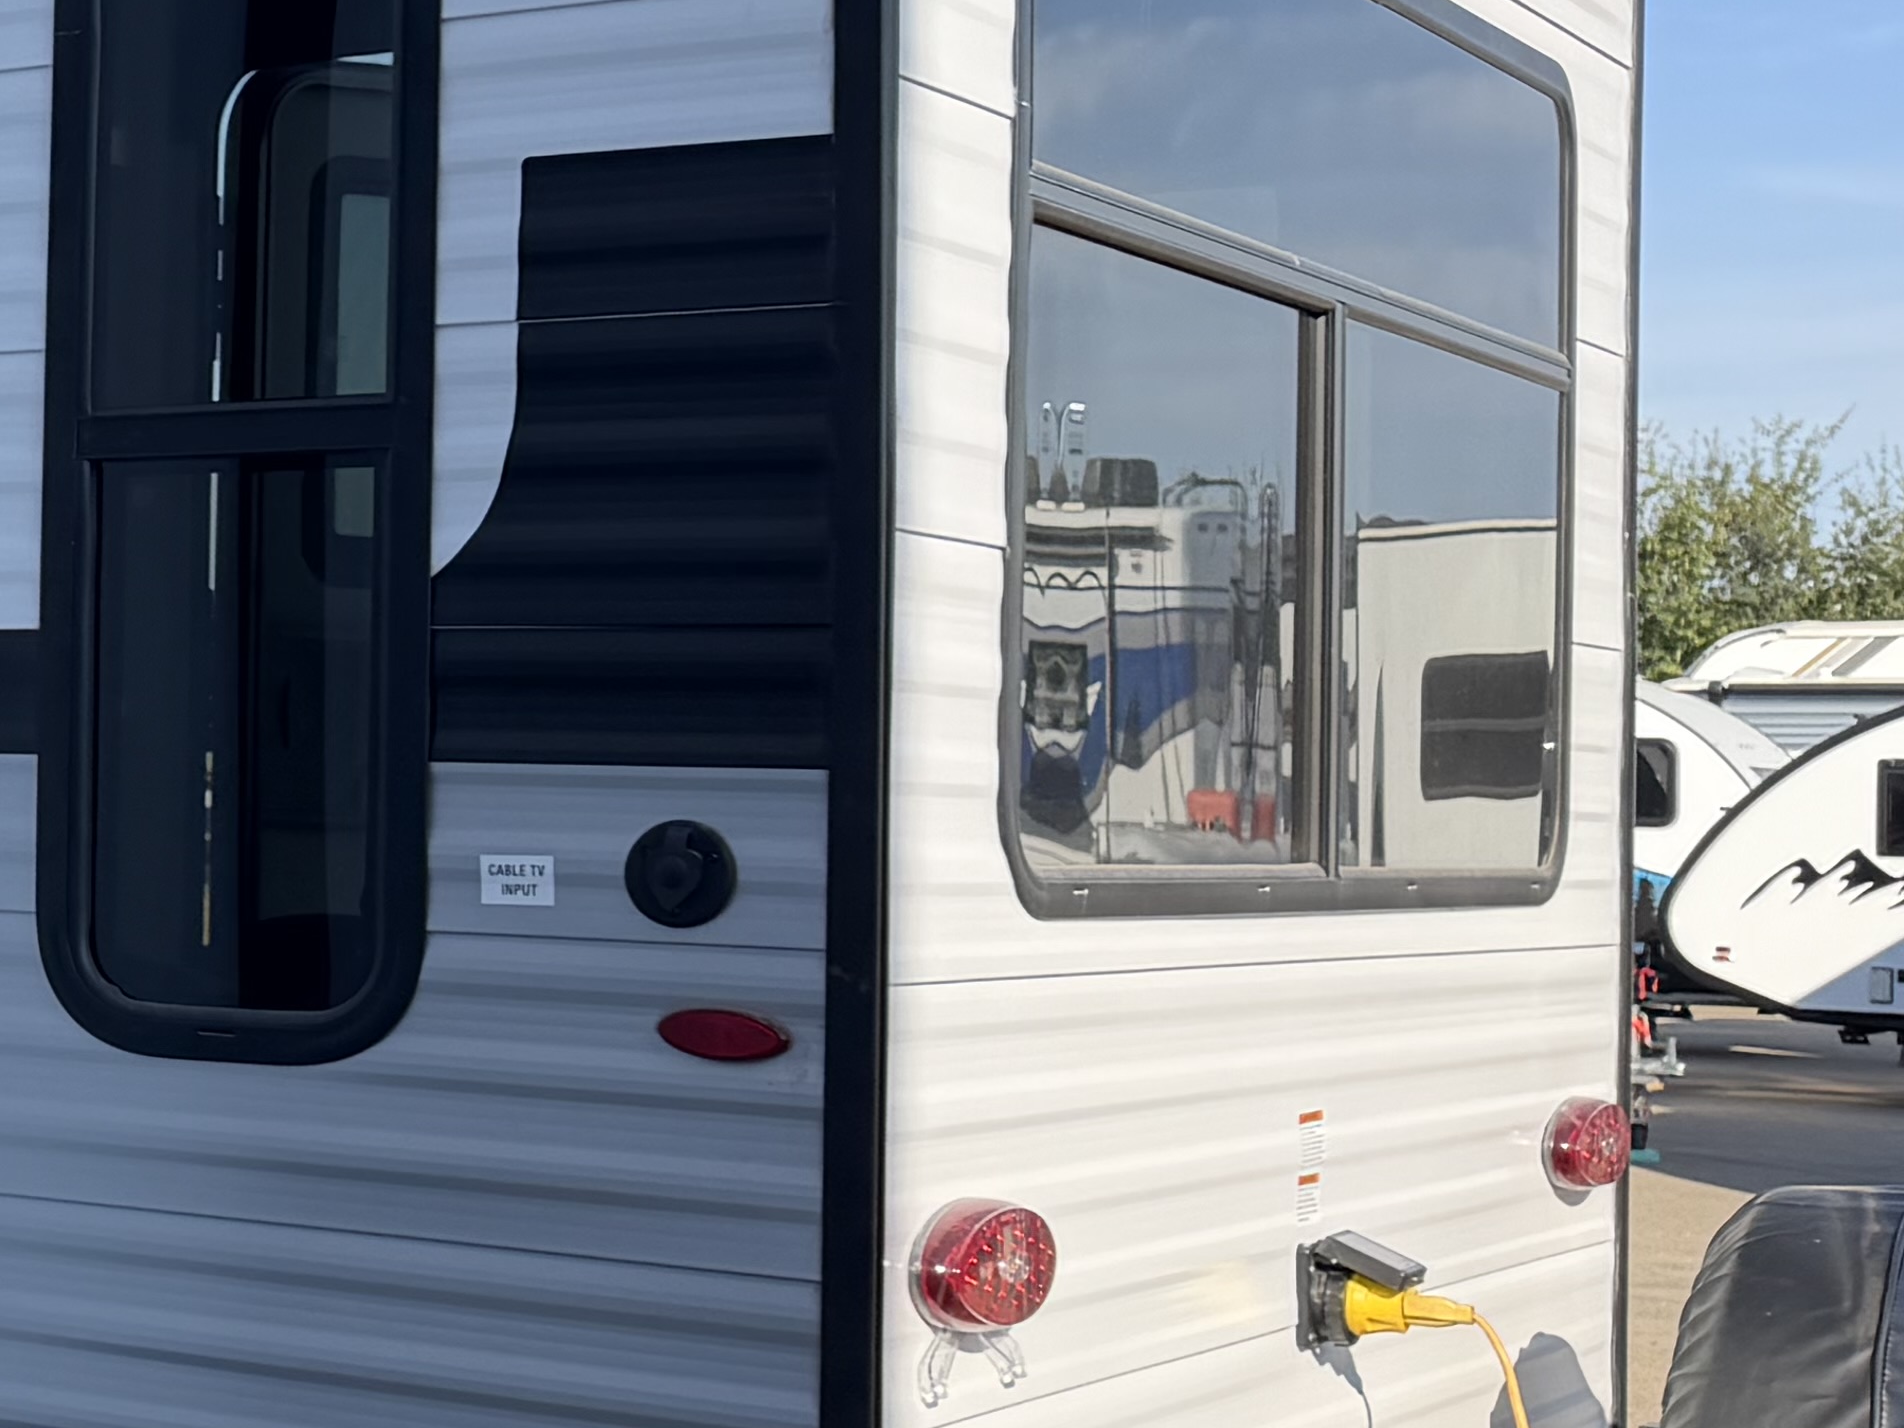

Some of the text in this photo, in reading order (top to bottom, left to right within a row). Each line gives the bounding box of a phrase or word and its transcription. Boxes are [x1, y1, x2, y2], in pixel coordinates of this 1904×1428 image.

[488, 863, 546, 877] CABLE TV
[501, 883, 538, 897] INPUT
